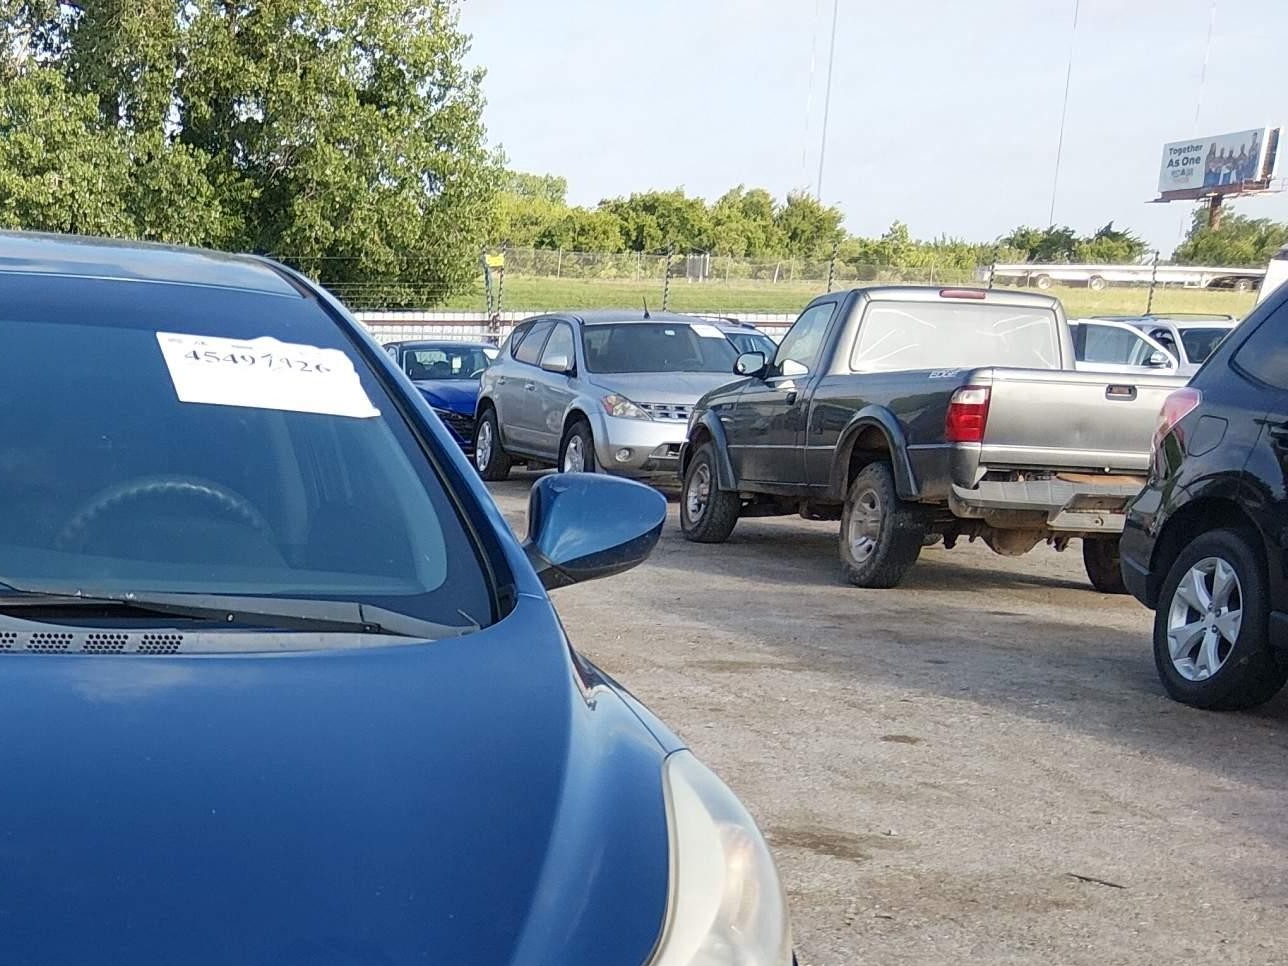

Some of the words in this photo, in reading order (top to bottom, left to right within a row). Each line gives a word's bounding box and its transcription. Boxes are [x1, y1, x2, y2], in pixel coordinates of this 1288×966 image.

[1168, 144, 1203, 156] Together
[1166, 158, 1180, 169] As
[1182, 156, 1201, 166] One
